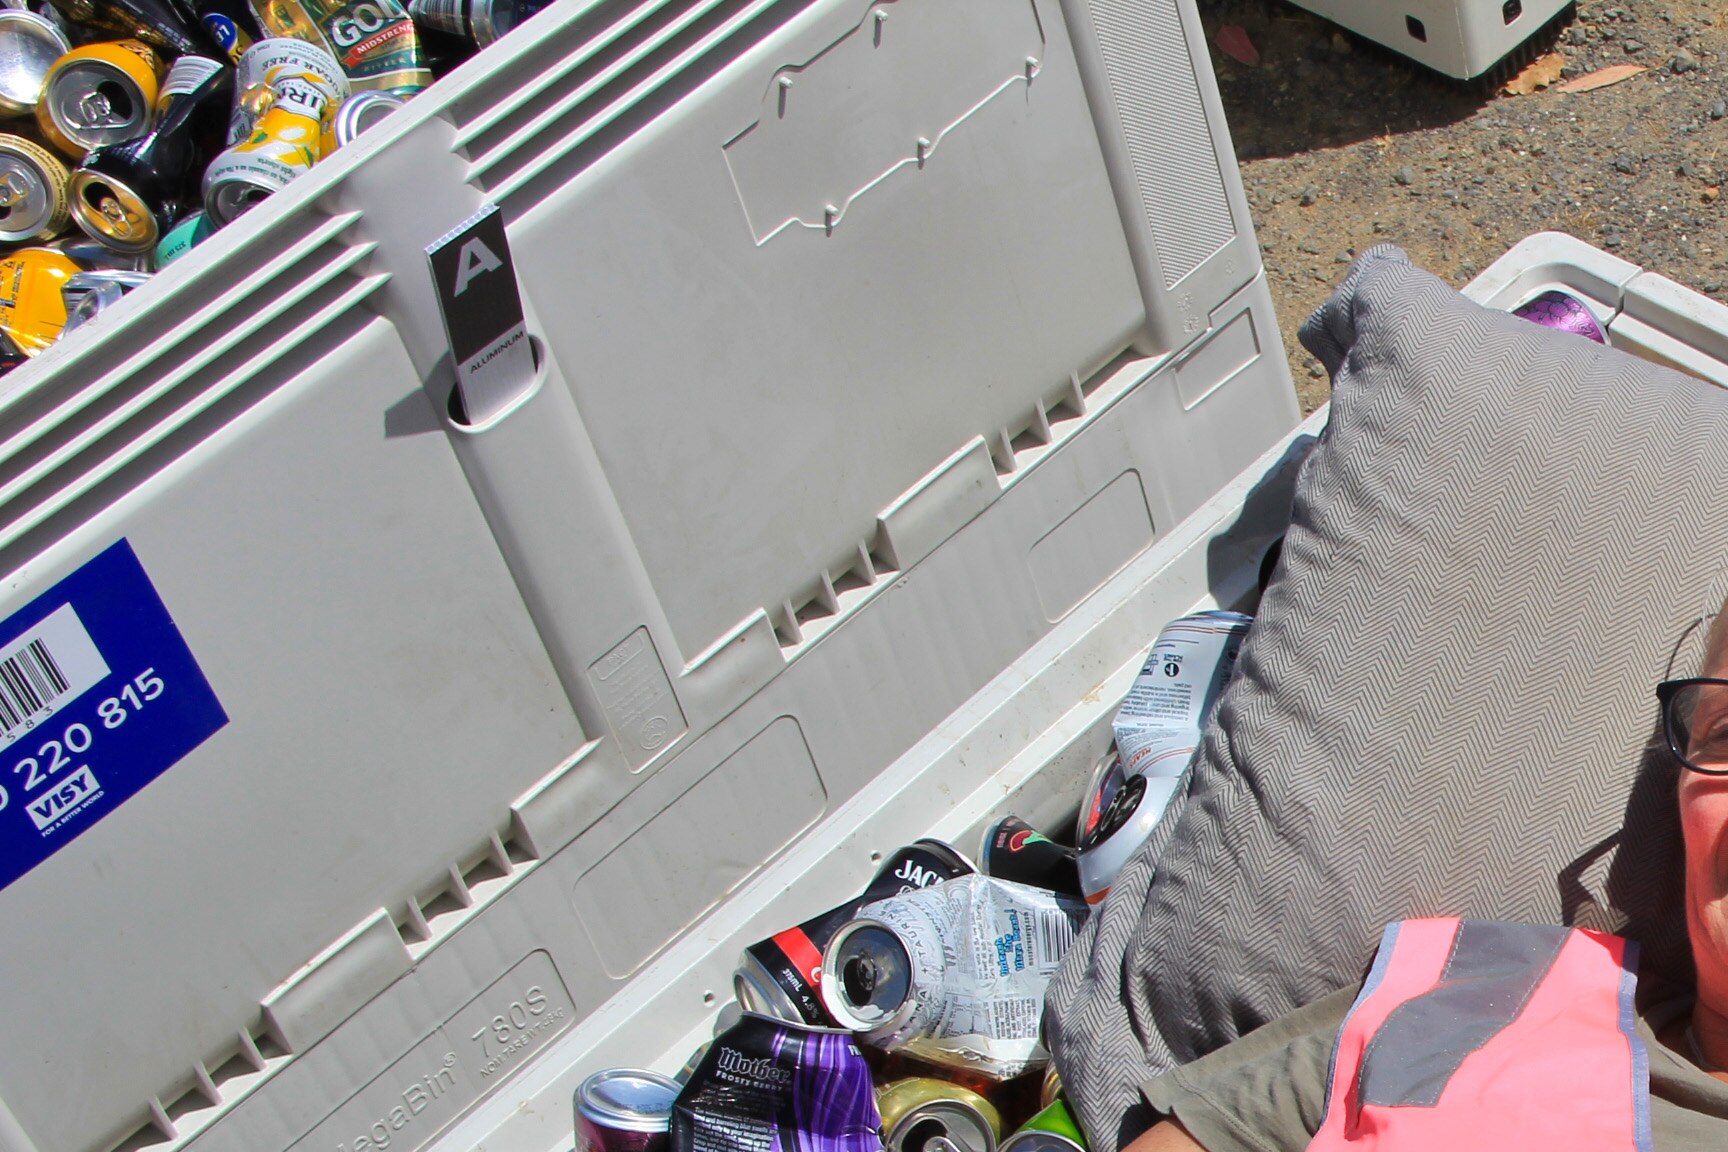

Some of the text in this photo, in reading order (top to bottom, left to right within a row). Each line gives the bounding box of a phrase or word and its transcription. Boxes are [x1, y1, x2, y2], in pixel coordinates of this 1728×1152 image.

[453, 236, 504, 298] A
[470, 330, 524, 374] ALUMINUM
[13, 666, 166, 792] 220 815
[33, 773, 90, 820] VISY
[41, 790, 105, 838] FOR A BETTER WORLD
[877, 908, 926, 959] TAURINE
[995, 936, 1009, 978] Unleash
[1014, 941, 1024, 972] Ultra
[781, 967, 821, 1020] 375mL 4.8%
[471, 985, 547, 1058] 780S
[715, 1070, 783, 1092] FROSTY BERRY
[717, 1046, 791, 1084] Mother
